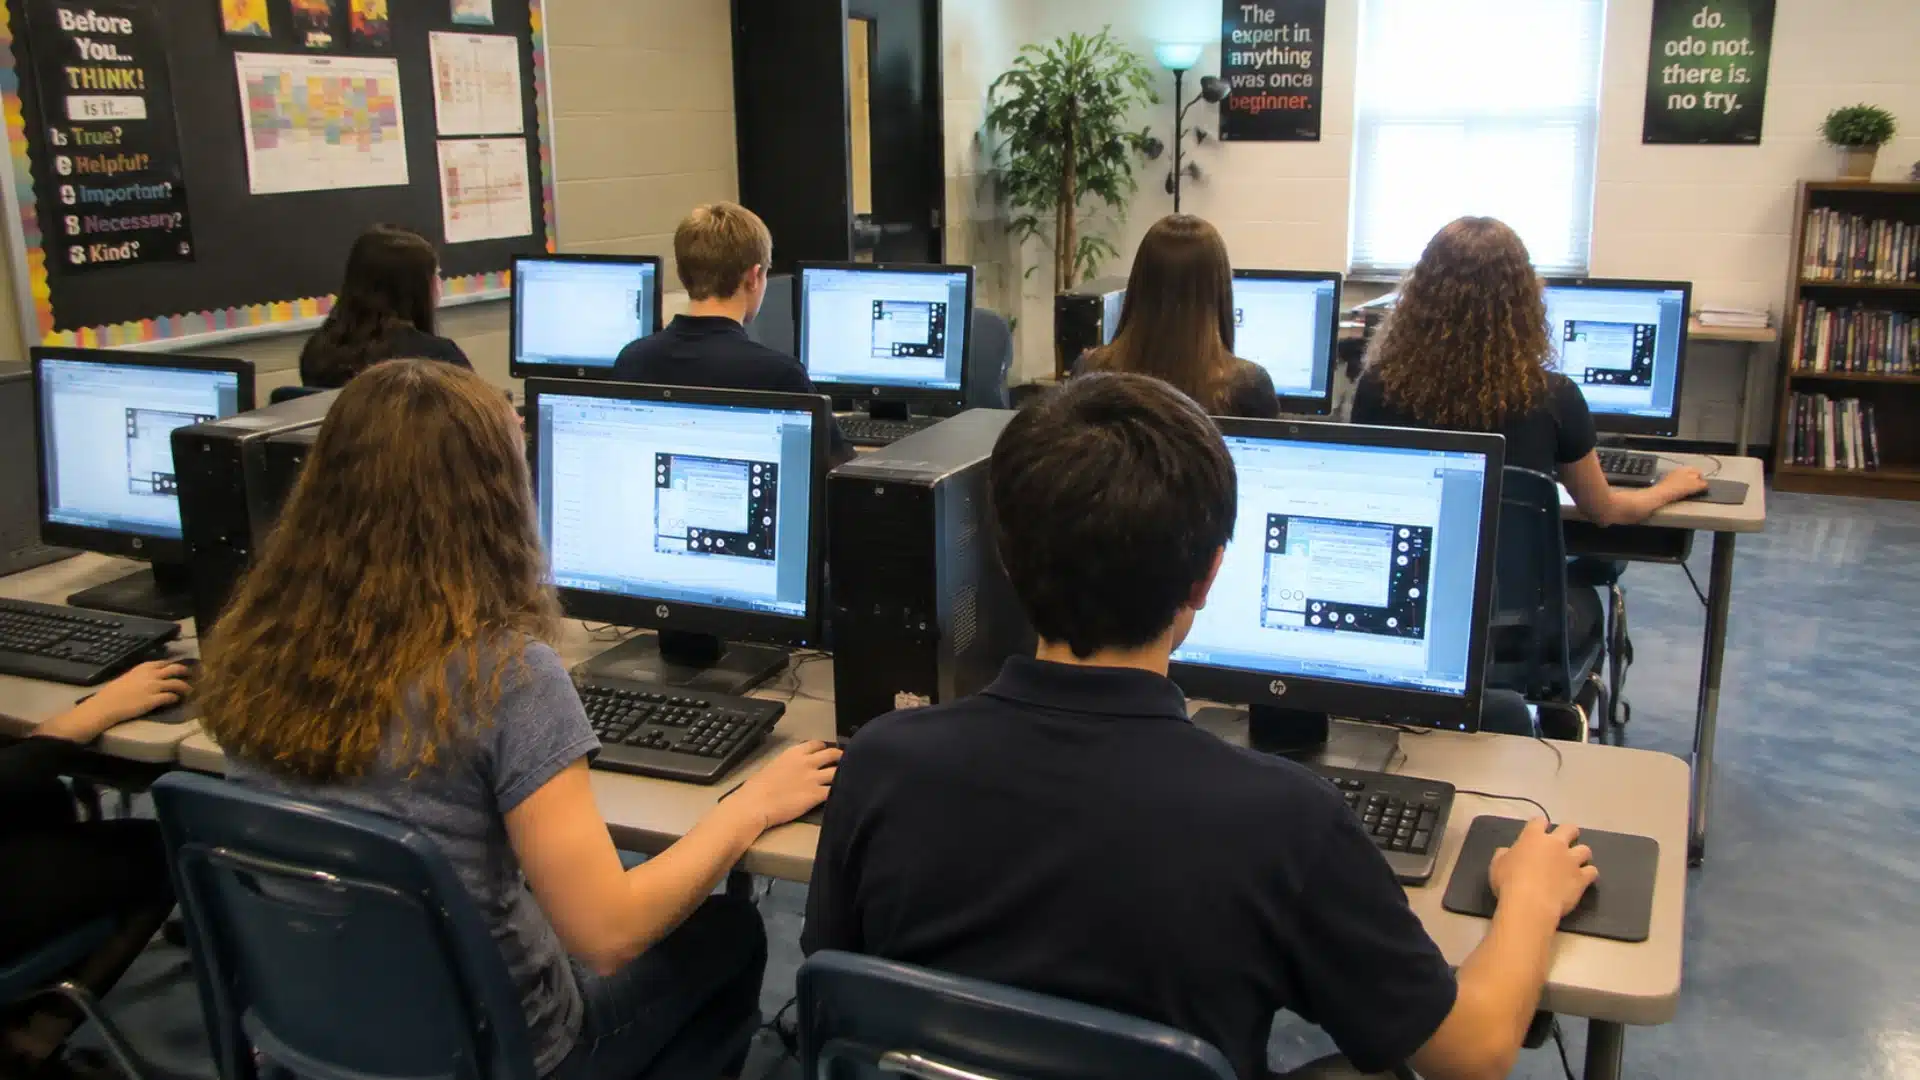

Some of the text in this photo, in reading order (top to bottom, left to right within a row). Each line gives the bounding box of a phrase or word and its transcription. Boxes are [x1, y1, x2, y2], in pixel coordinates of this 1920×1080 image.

[57, 8, 133, 35] Before
[1240, 4, 1276, 24] The
[1692, 6, 1726, 29] do.
[1231, 24, 1312, 48] expert in
[1664, 36, 1755, 57] odo not.
[74, 37, 133, 62] You...
[1230, 46, 1313, 70] anything
[65, 66, 146, 90] THINK!
[1231, 73, 1313, 88] was once
[1662, 63, 1751, 84] there is.
[84, 100, 99, 116] is
[1229, 91, 1312, 114] beginner.
[1667, 91, 1743, 115] no try.
[70, 126, 122, 146] True?
[75, 153, 149, 177] Helpful?
[80, 181, 172, 207] Important?
[84, 211, 182, 233] Necessary?
[88, 240, 141, 263] Kind?
